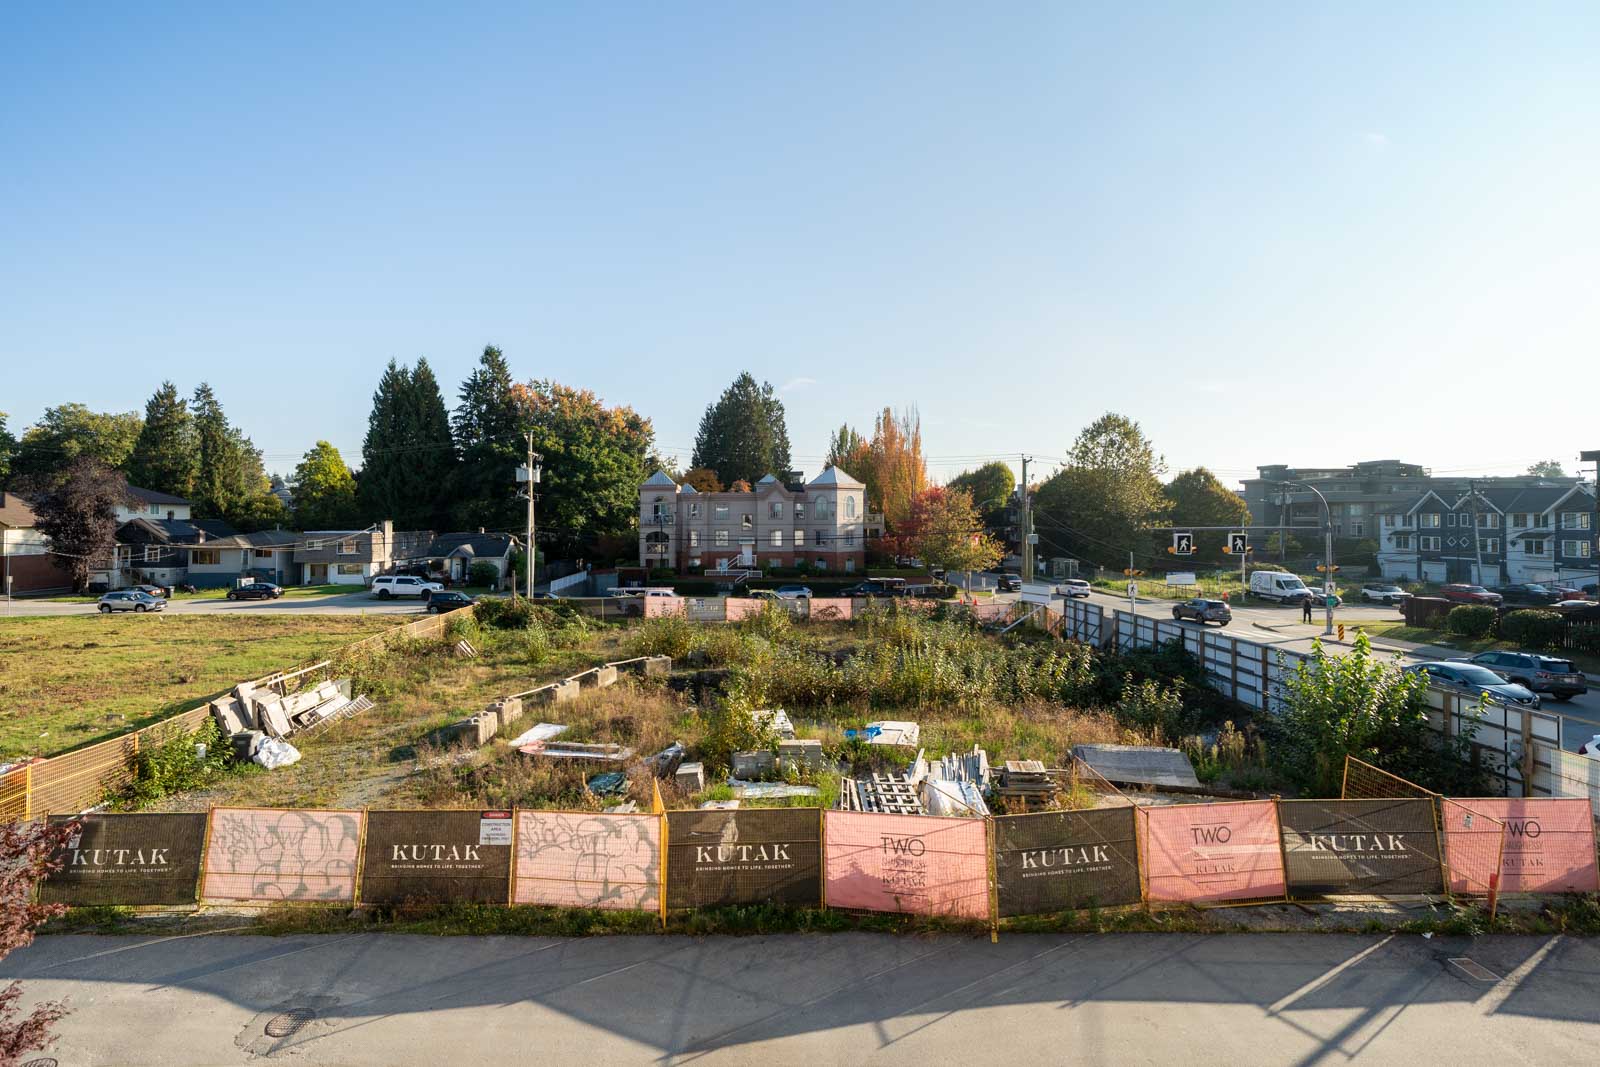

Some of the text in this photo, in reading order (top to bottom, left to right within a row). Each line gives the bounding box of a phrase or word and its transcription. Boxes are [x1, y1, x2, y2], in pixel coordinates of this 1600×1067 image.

[1190, 826, 1231, 845] TWO
[1508, 820, 1541, 838] WO
[880, 836, 926, 856] TWO
[1310, 834, 1406, 851] KUTAK
[72, 848, 169, 865] KUTAK
[392, 844, 480, 860] KUTAK
[696, 844, 790, 862] KUTAK
[1022, 846, 1110, 869] KUTAK
